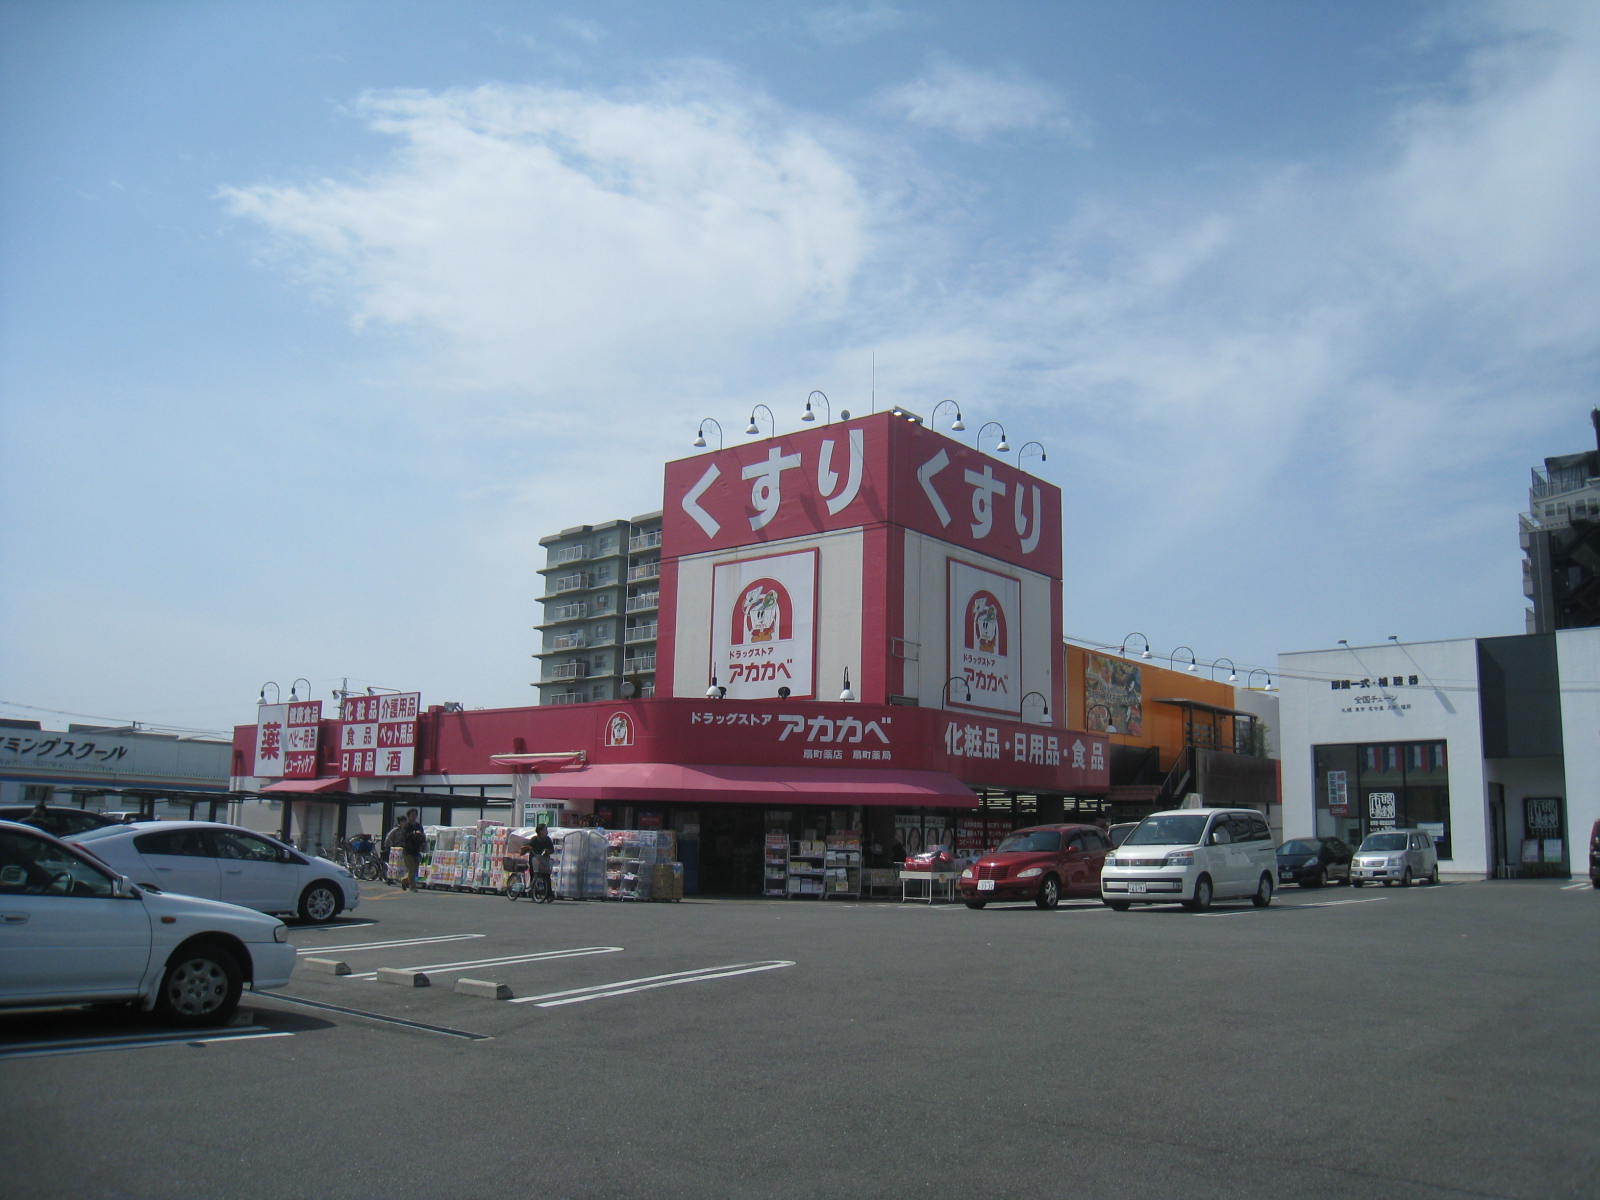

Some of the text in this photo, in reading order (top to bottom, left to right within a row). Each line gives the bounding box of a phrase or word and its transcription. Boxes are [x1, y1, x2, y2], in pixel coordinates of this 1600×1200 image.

[682, 428, 864, 540] くすり
[917, 447, 1041, 554] くすり
[728, 646, 774, 659] ドラッグストア
[728, 658, 793, 684] アカカベ
[963, 667, 1009, 695] アカカベ
[344, 700, 377, 721] 化粧品
[381, 696, 416, 720] 介護用品
[379, 723, 414, 746] ペット用品
[691, 712, 892, 744] ドラッグストア アカカベ
[260, 722, 283, 761] 薬
[342, 752, 374, 773] 日用品
[386, 751, 402, 772] 酒
